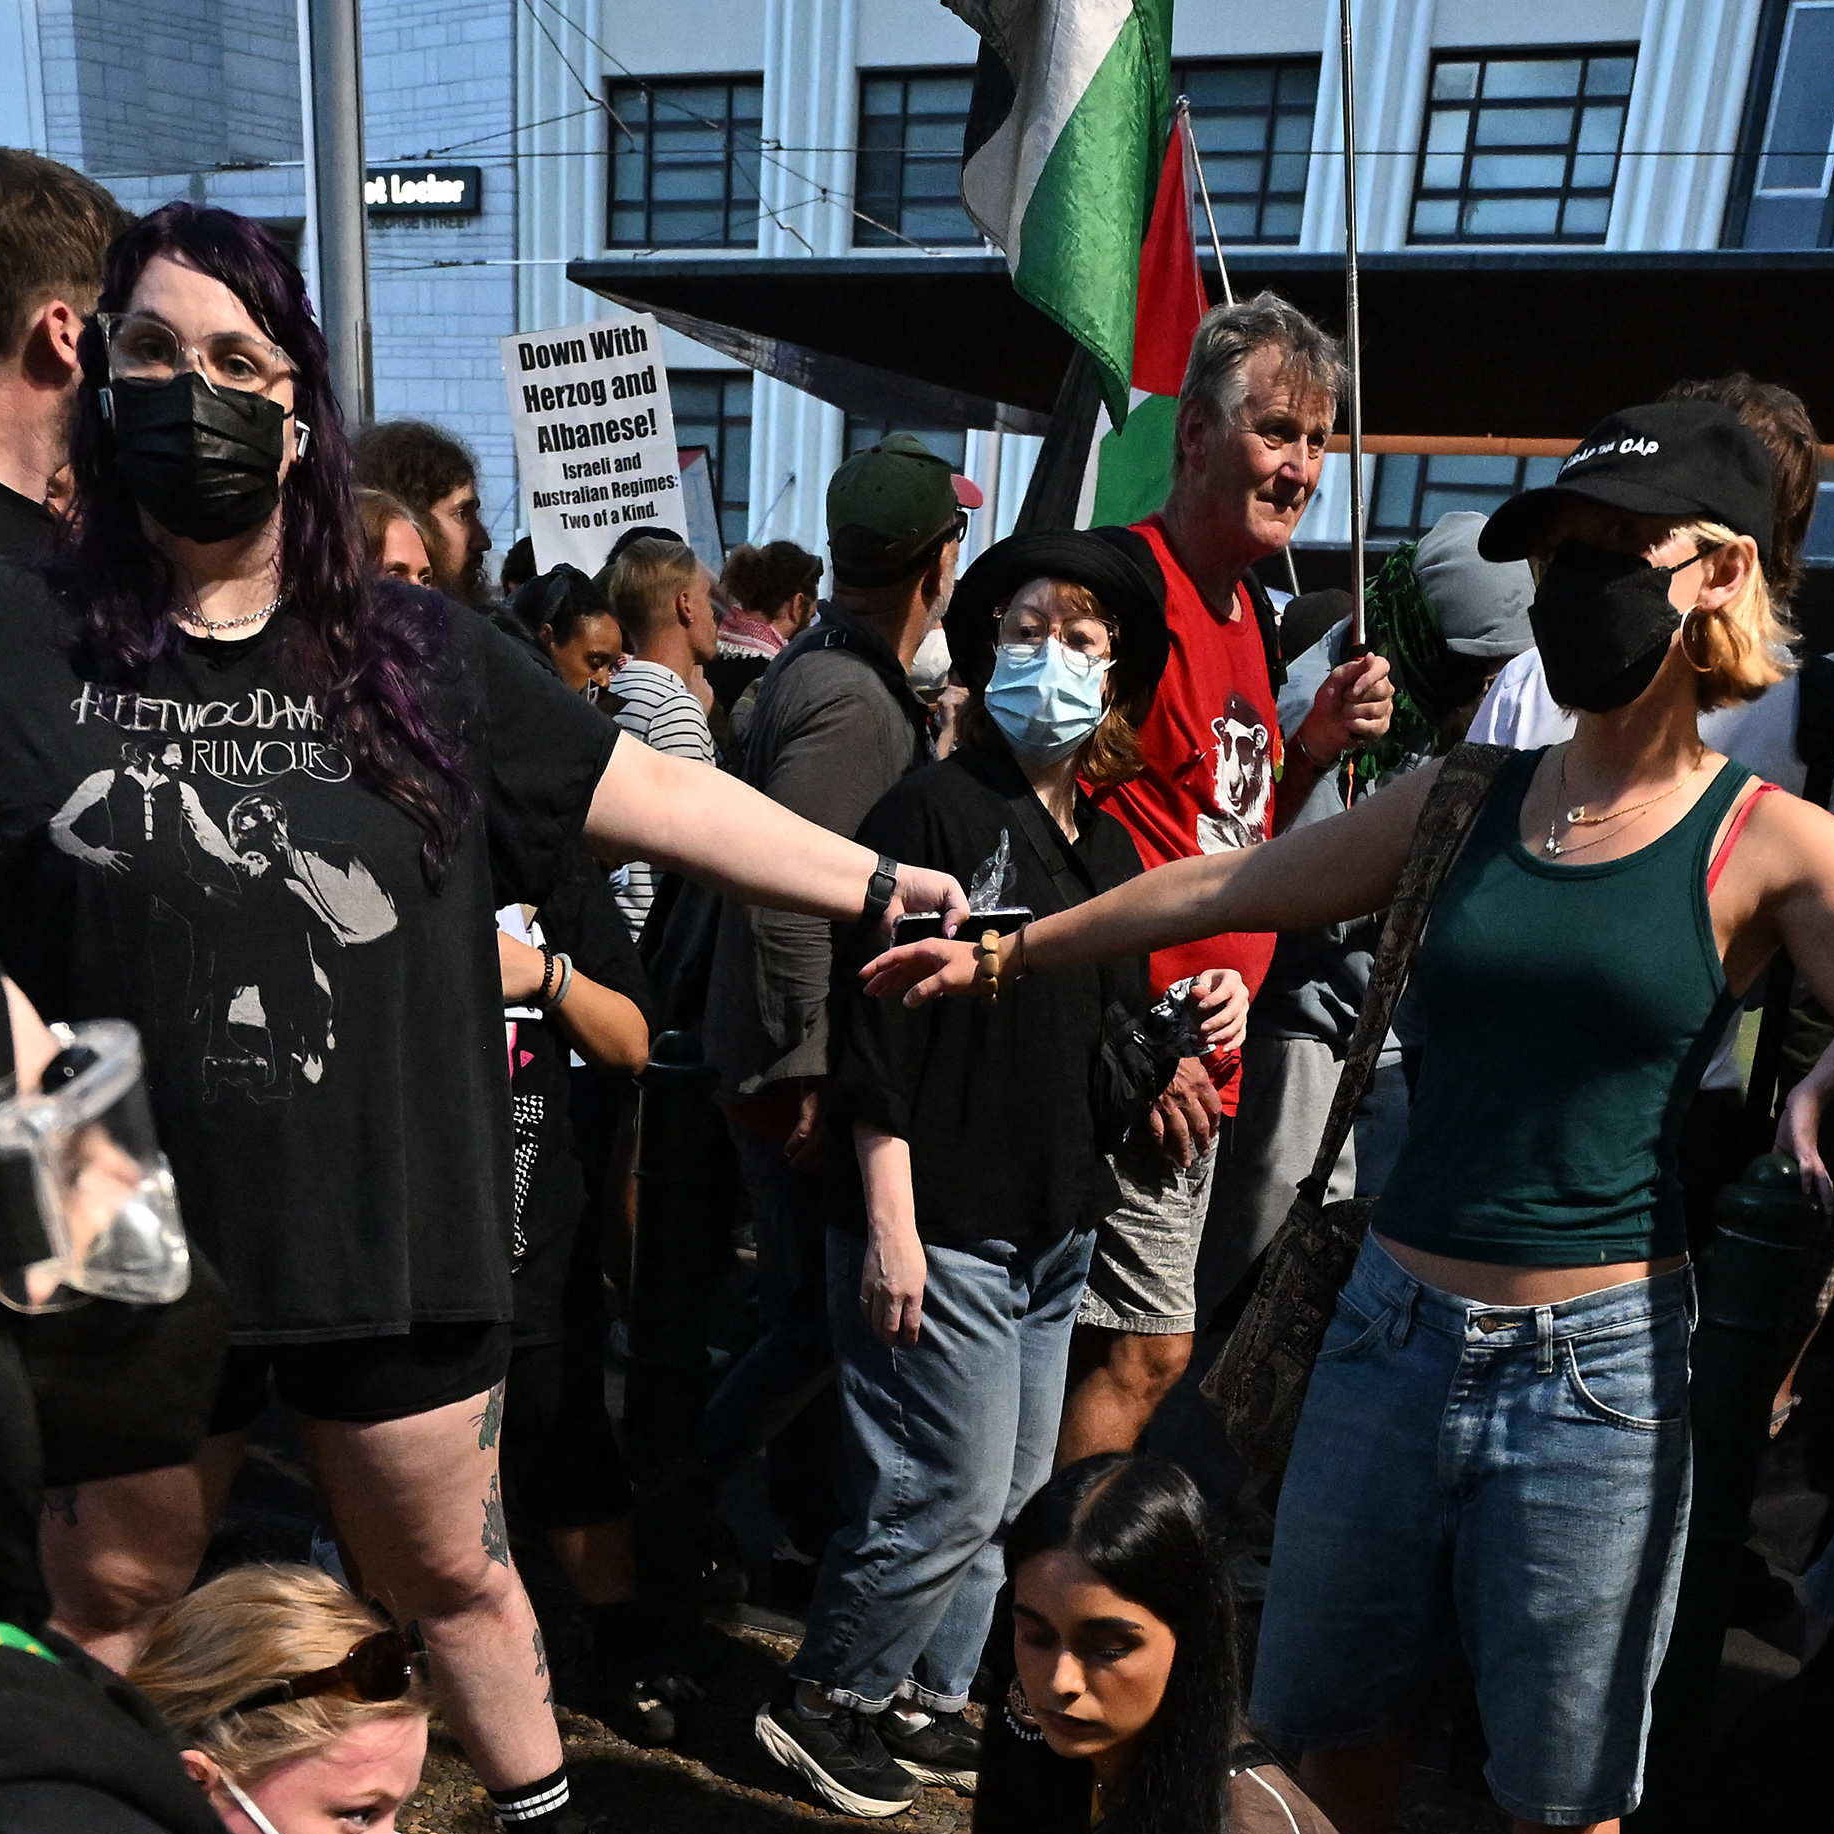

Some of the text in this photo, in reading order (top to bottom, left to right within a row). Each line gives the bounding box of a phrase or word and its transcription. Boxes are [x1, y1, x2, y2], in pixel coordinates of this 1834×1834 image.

[518, 325, 648, 371] Down With
[522, 365, 657, 413] Herzog and
[537, 408, 657, 453] Albanese!
[562, 452, 642, 480] Israeli and
[532, 475, 679, 509] Australian Regimes:
[560, 501, 659, 530] Two of a Kind.
